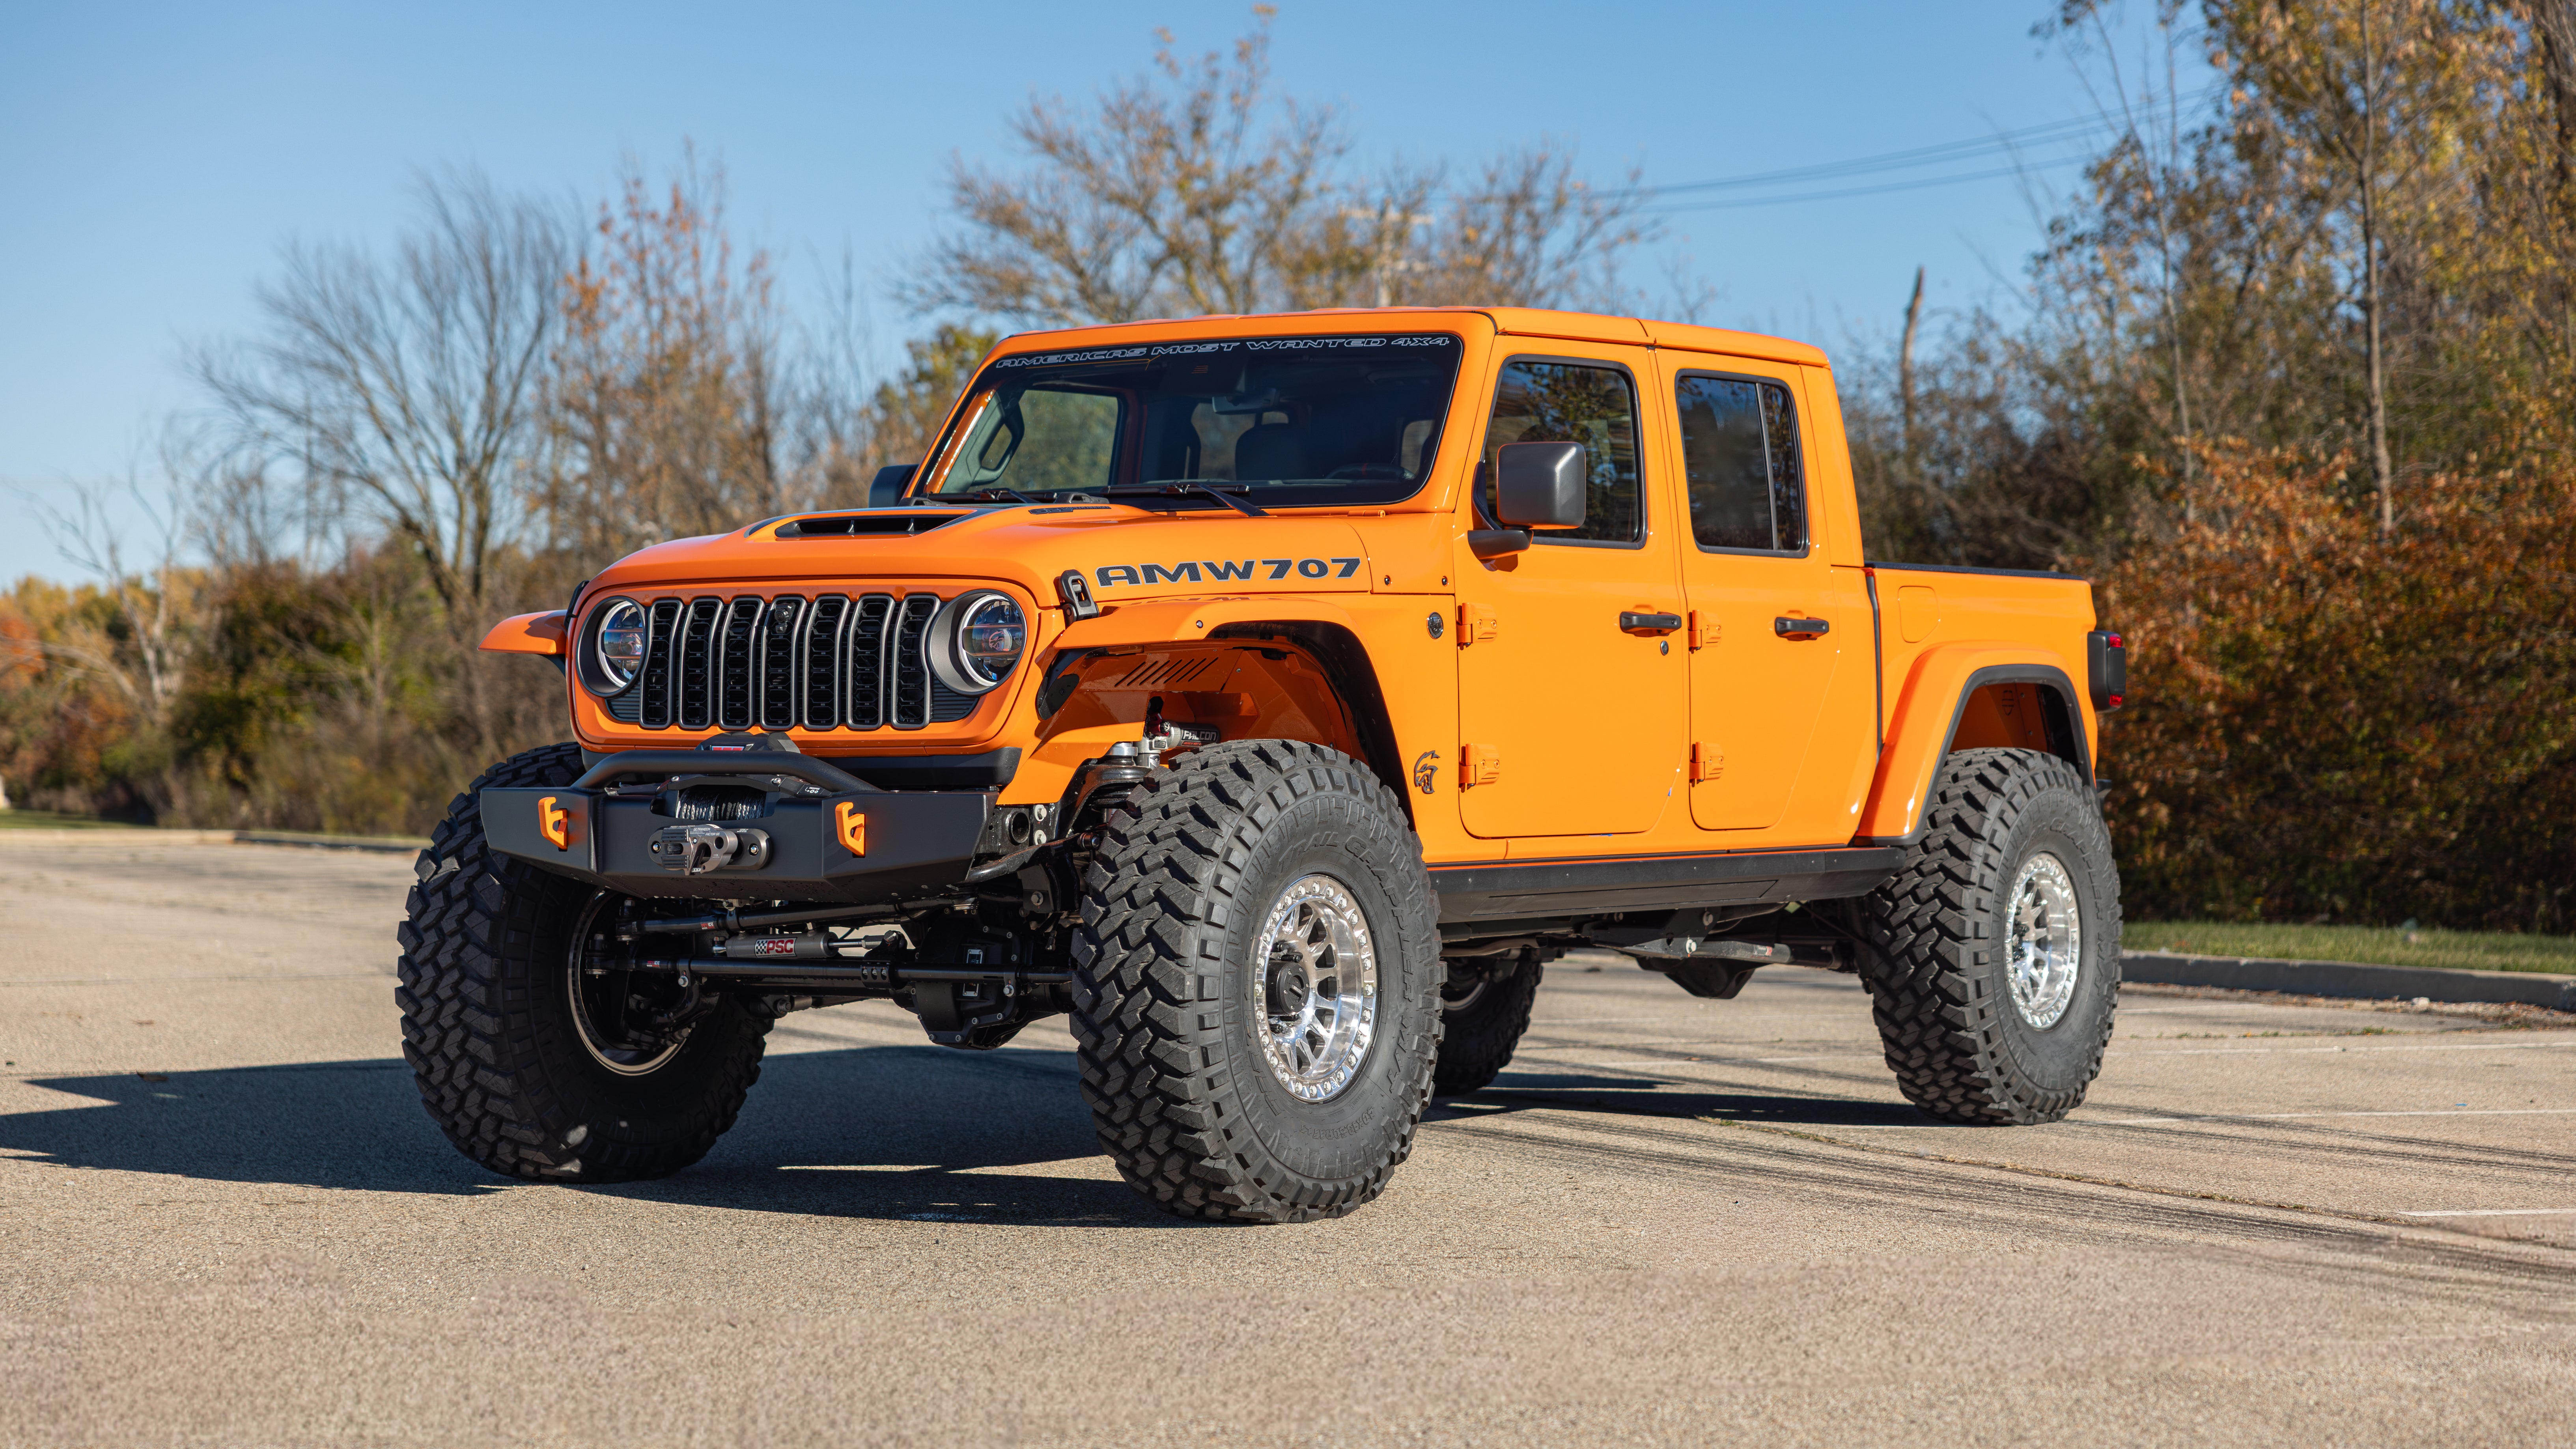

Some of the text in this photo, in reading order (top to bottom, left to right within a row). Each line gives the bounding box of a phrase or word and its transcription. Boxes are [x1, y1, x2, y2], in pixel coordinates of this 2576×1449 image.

[996, 337, 1450, 368] AMERICAS MOST WANTED 4X4
[1183, 730, 1216, 741] FALCON
[767, 939, 794, 954] PSC
